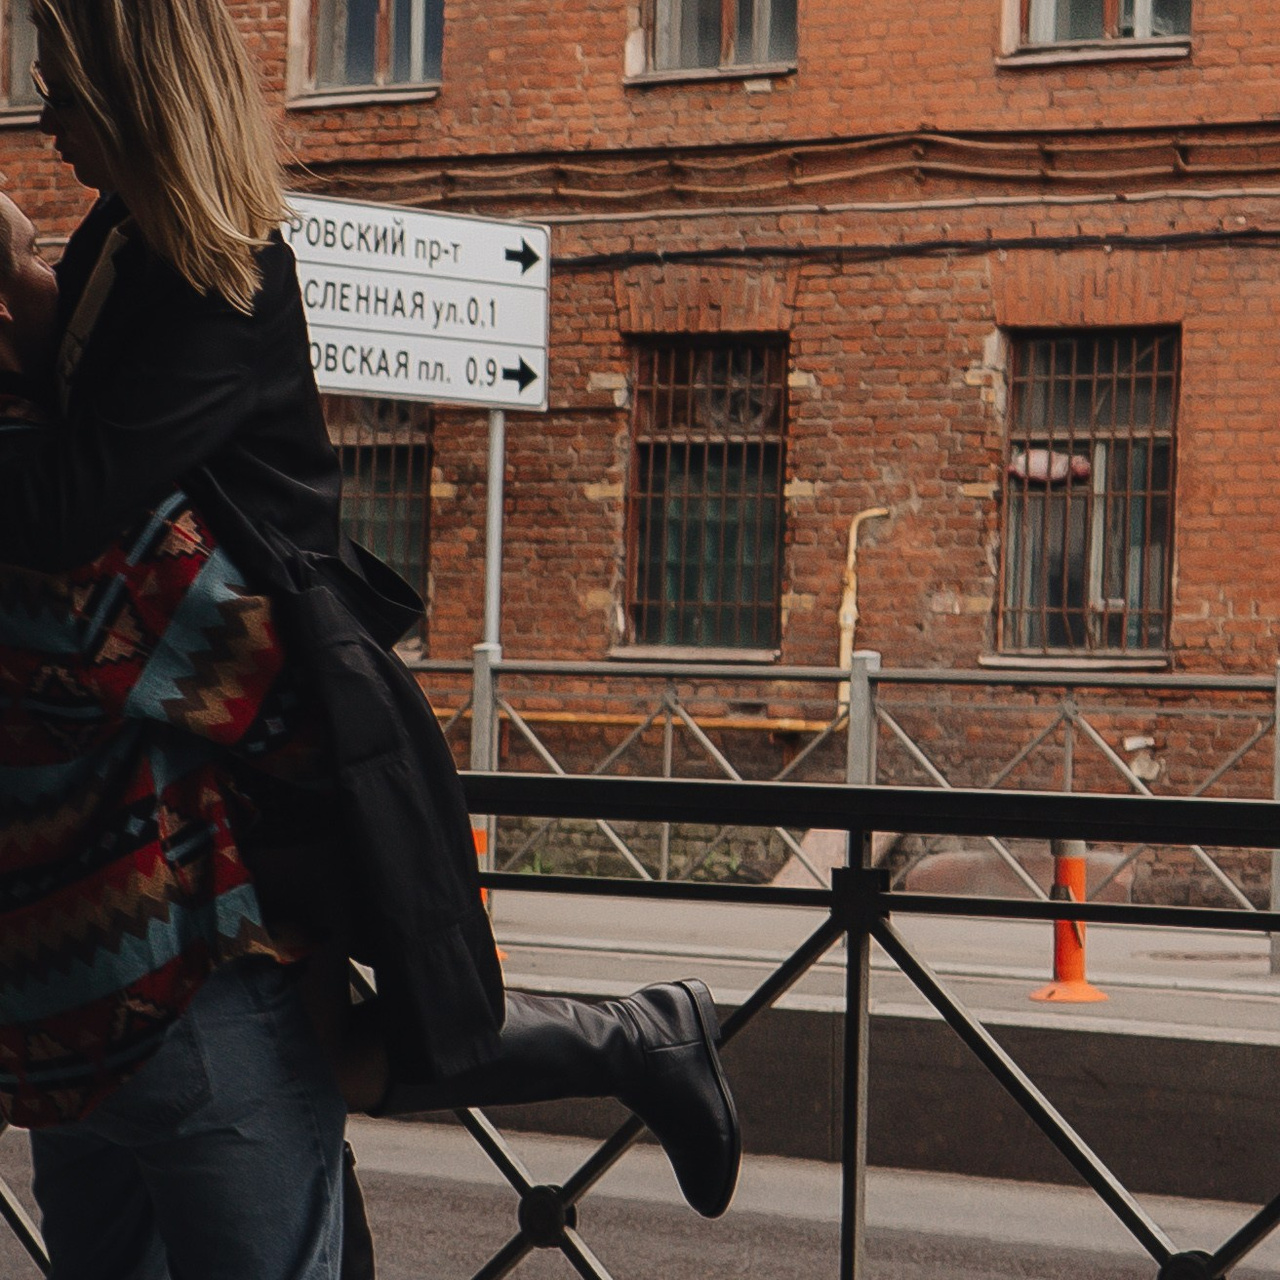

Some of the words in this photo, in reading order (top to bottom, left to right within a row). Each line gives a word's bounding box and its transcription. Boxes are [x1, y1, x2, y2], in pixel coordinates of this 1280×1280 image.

[415, 237, 461, 268] пр-т
[304, 279, 424, 321] СЛЕННАЯ
[418, 360, 451, 384] пл.
